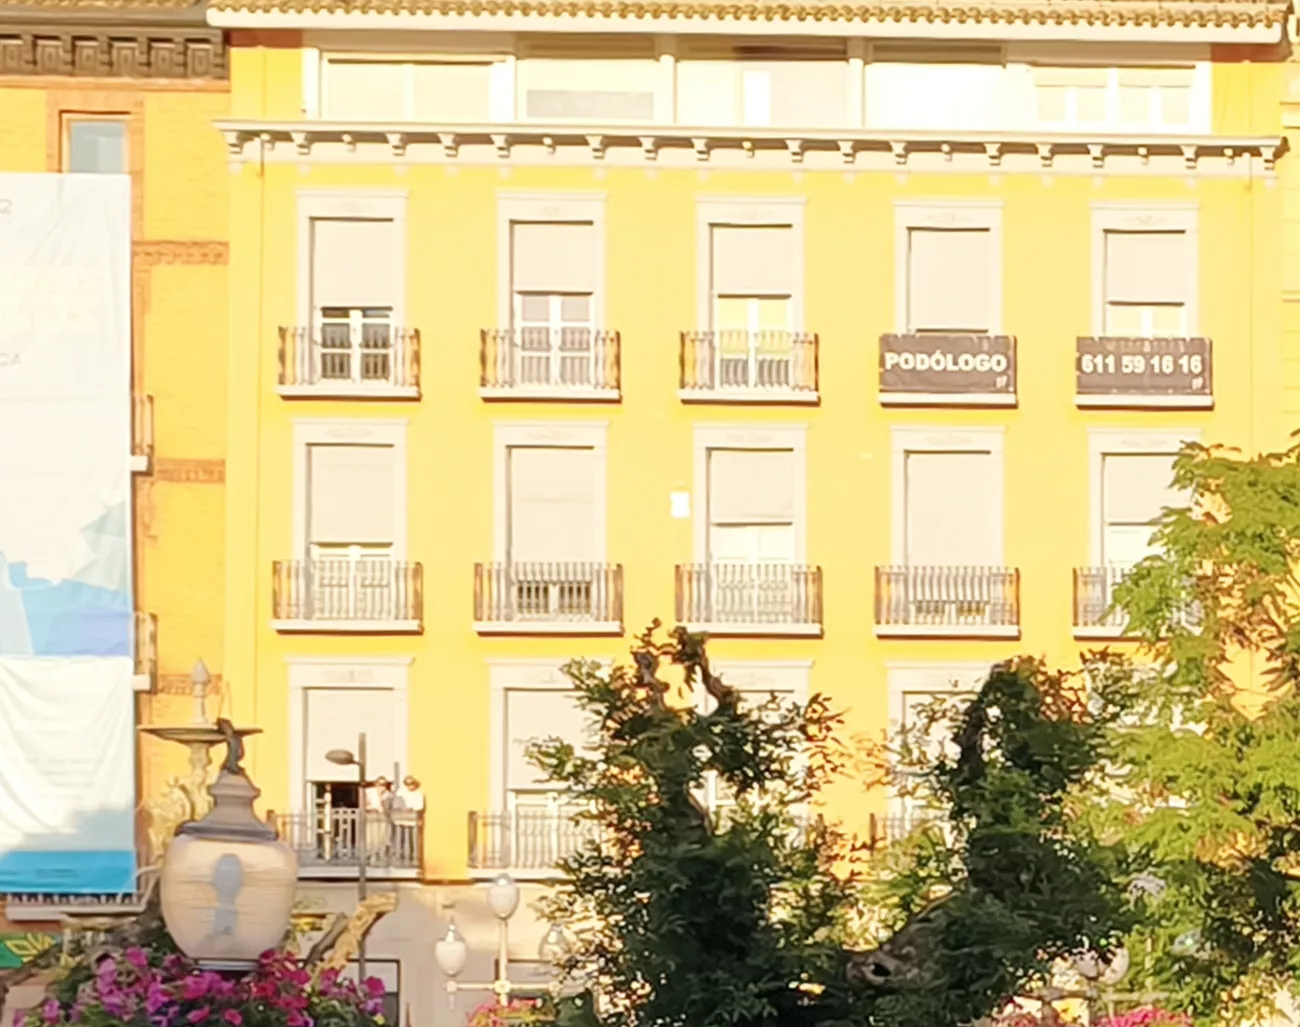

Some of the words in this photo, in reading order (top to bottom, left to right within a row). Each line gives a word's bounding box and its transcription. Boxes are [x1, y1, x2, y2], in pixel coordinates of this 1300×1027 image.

[884, 350, 1007, 372] PODÓLOGO
[1081, 355, 1114, 373] 611
[1122, 355, 1145, 373] 59
[1150, 355, 1173, 373] 16
[1178, 355, 1202, 374] 16
